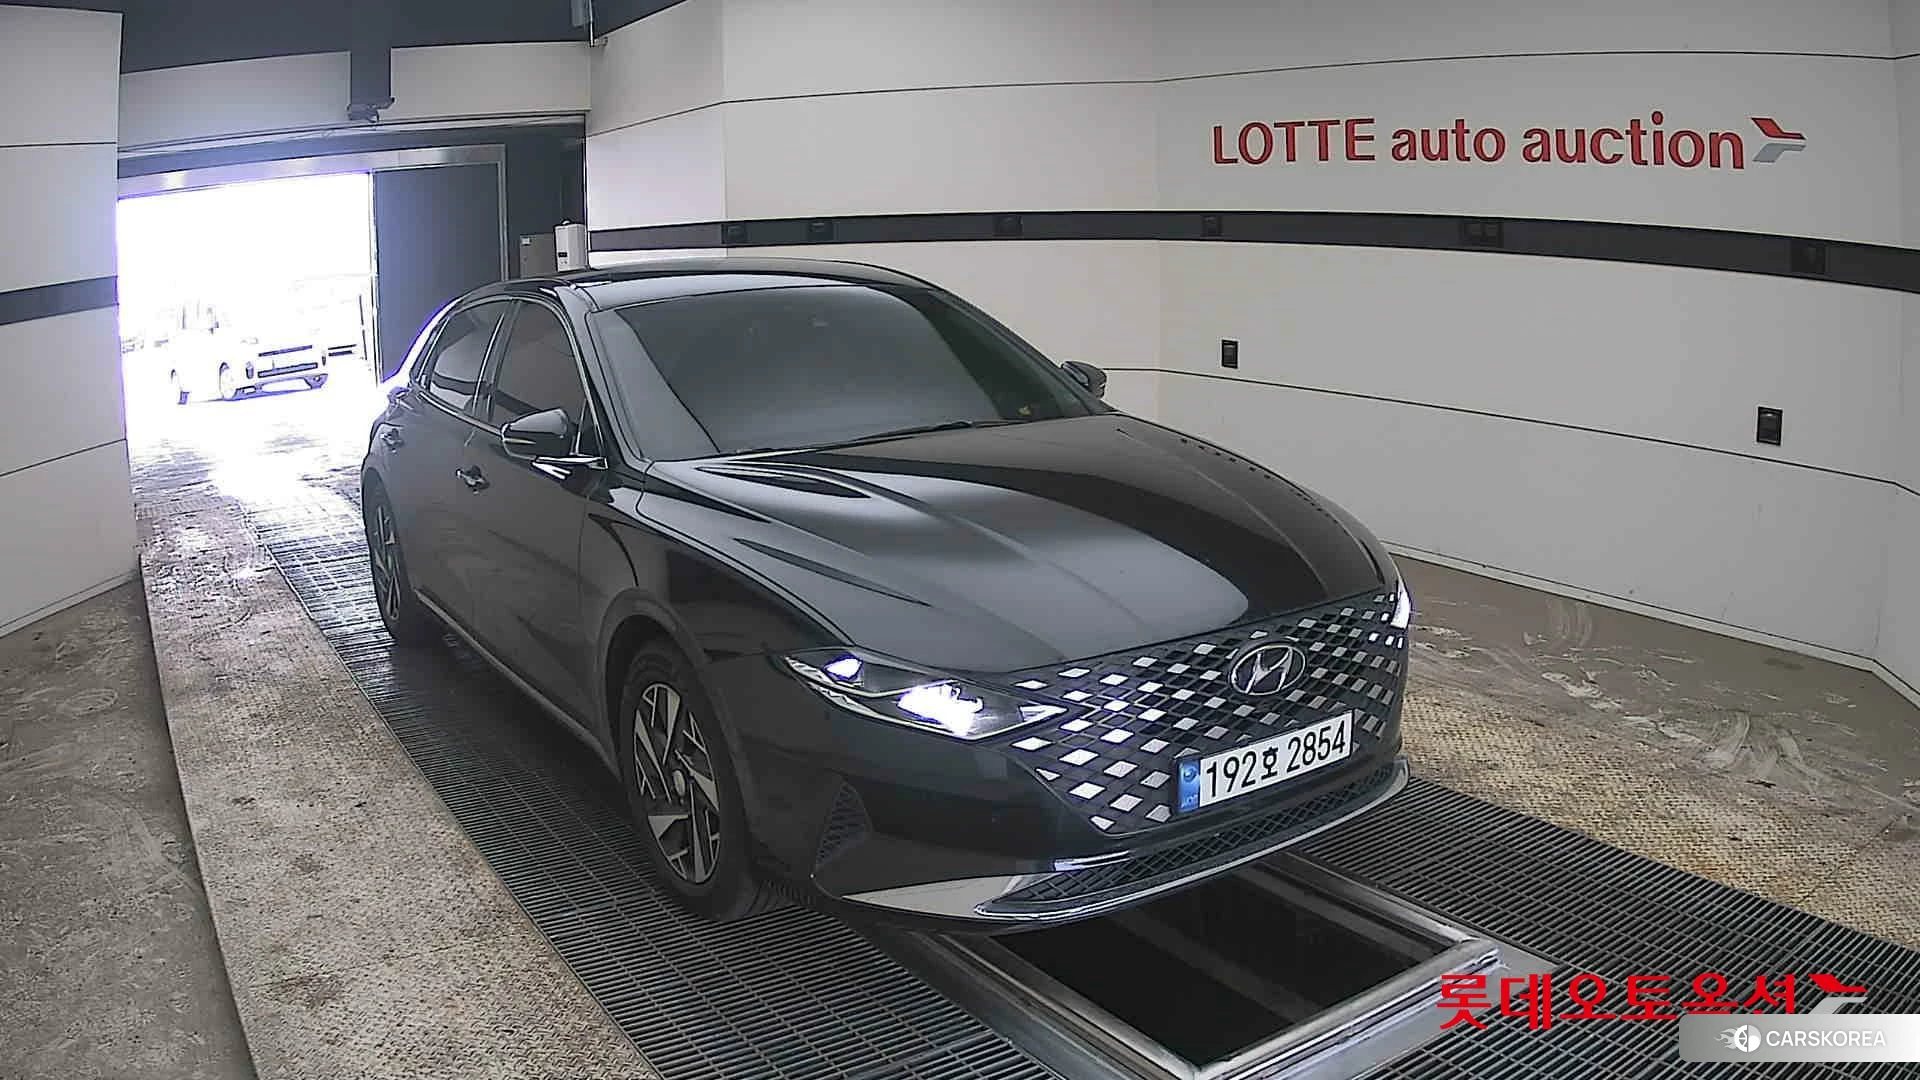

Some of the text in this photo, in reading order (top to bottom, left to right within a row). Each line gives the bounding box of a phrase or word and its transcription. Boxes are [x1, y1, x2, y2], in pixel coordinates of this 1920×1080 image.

[1213, 111, 1744, 170] LOTTE auto auction
[1206, 720, 1346, 798] 192호 2854
